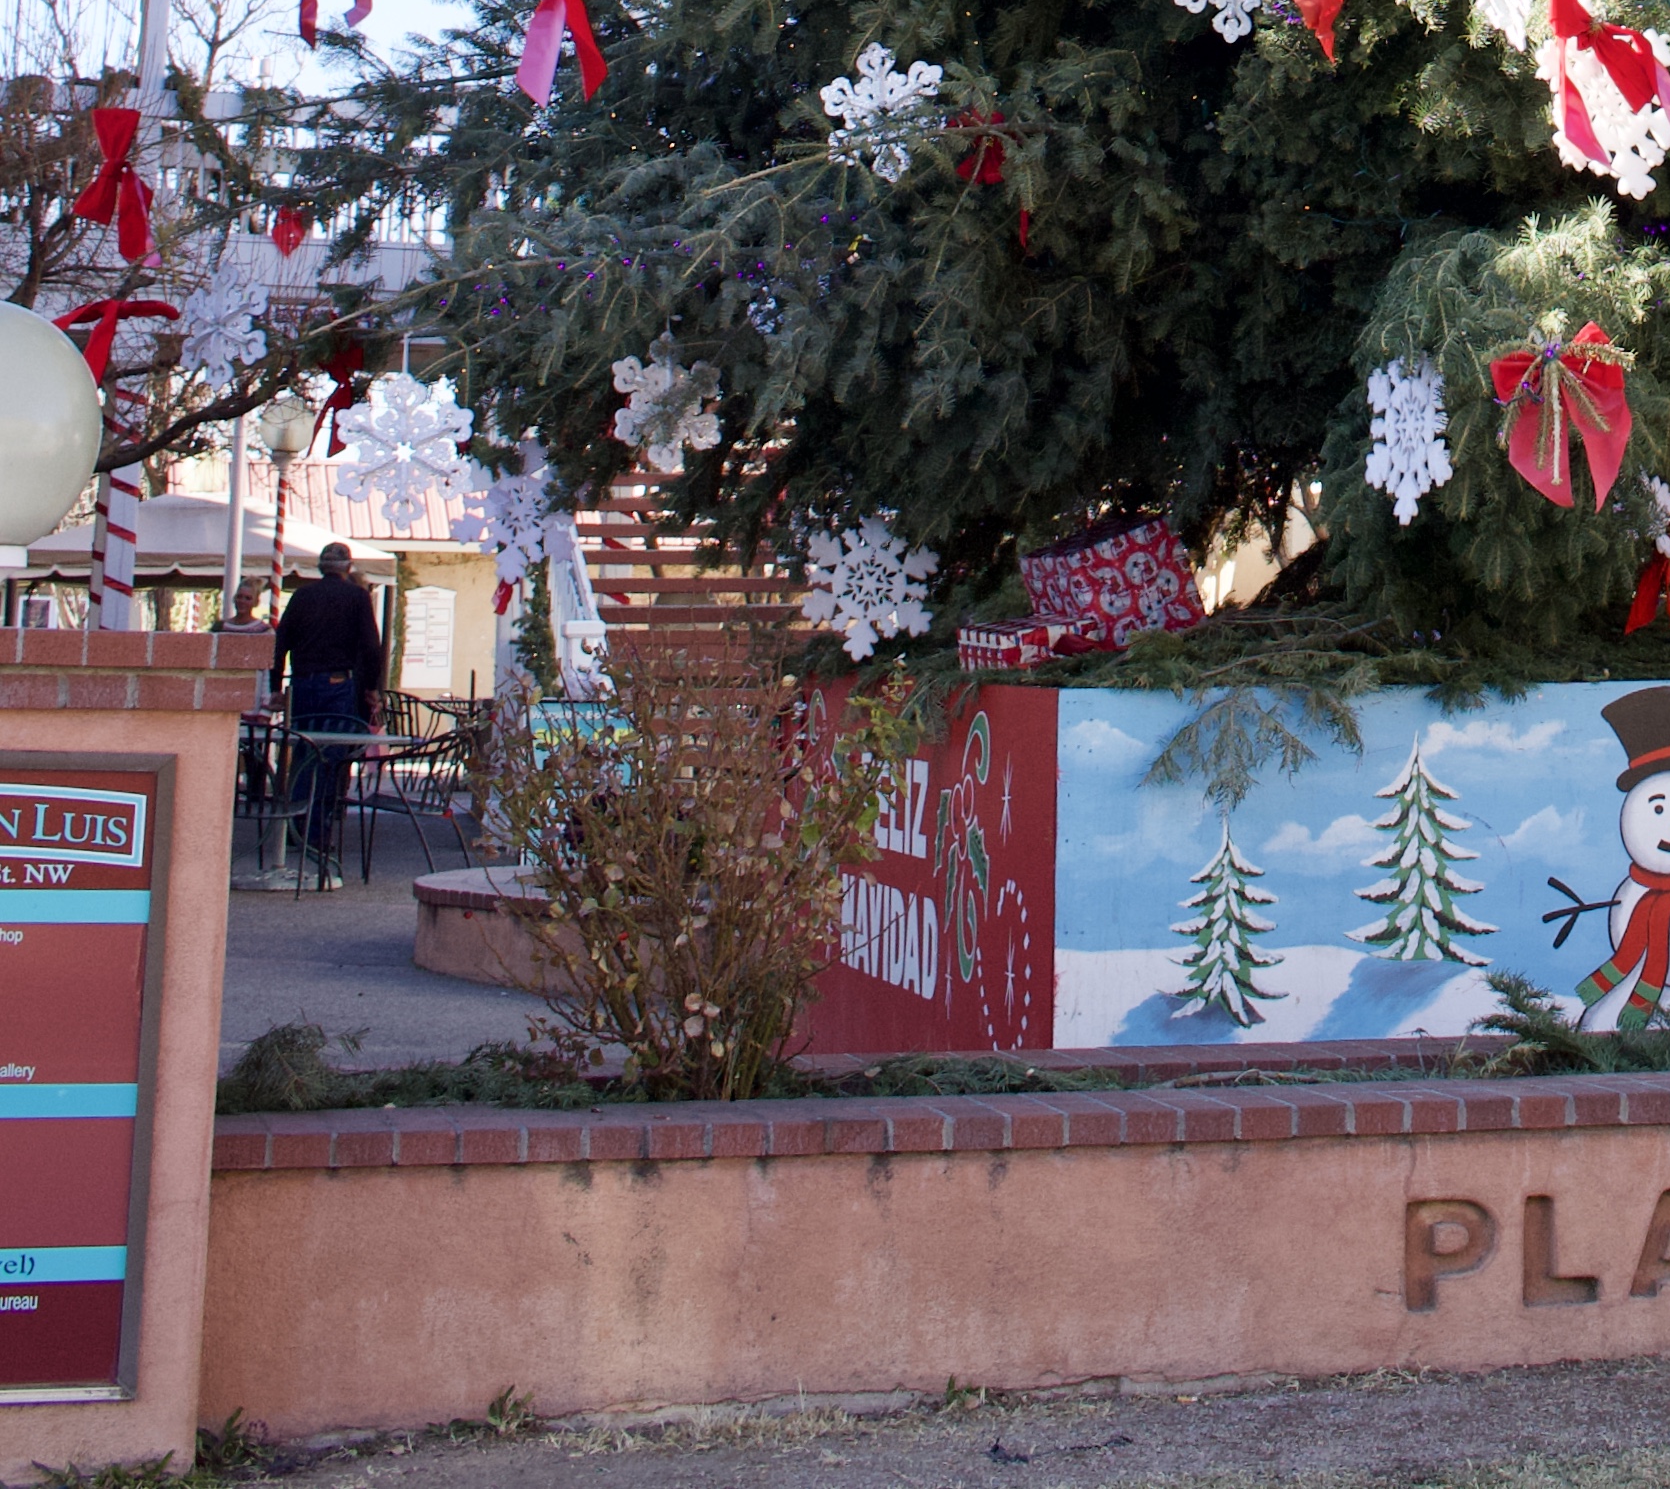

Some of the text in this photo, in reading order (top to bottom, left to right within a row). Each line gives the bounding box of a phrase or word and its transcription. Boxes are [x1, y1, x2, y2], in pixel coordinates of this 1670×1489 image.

[32, 803, 128, 847] LUIS
[24, 863, 75, 884] NW
[840, 873, 939, 1000] NAVIDAD
[0, 1254, 35, 1276] el)
